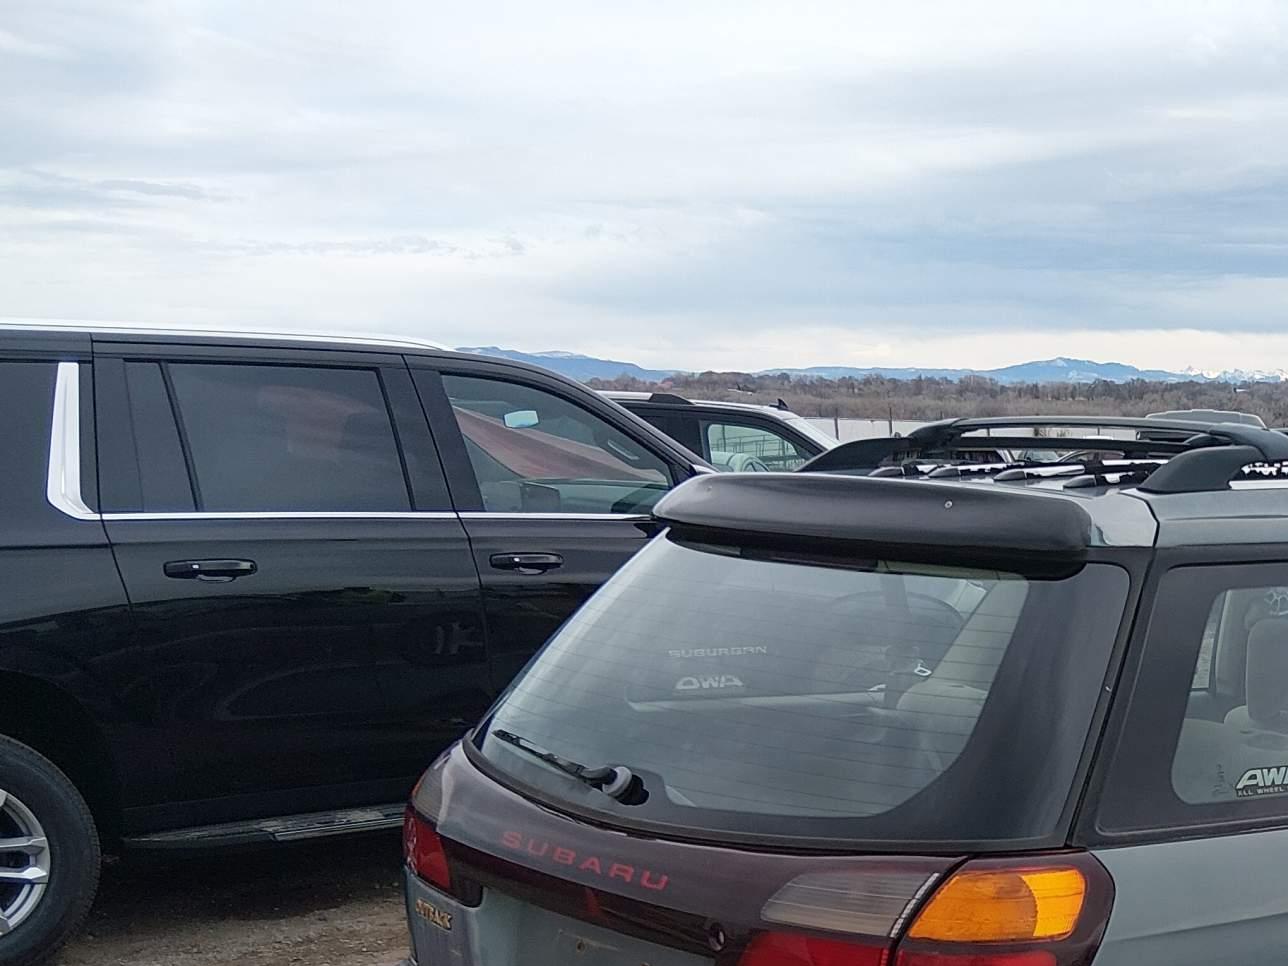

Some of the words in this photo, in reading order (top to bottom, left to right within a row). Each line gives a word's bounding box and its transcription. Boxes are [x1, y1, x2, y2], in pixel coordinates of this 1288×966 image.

[668, 645, 768, 658] SUBURBAN
[1256, 786, 1285, 795] WHEEL
[501, 831, 670, 891] SUBARU
